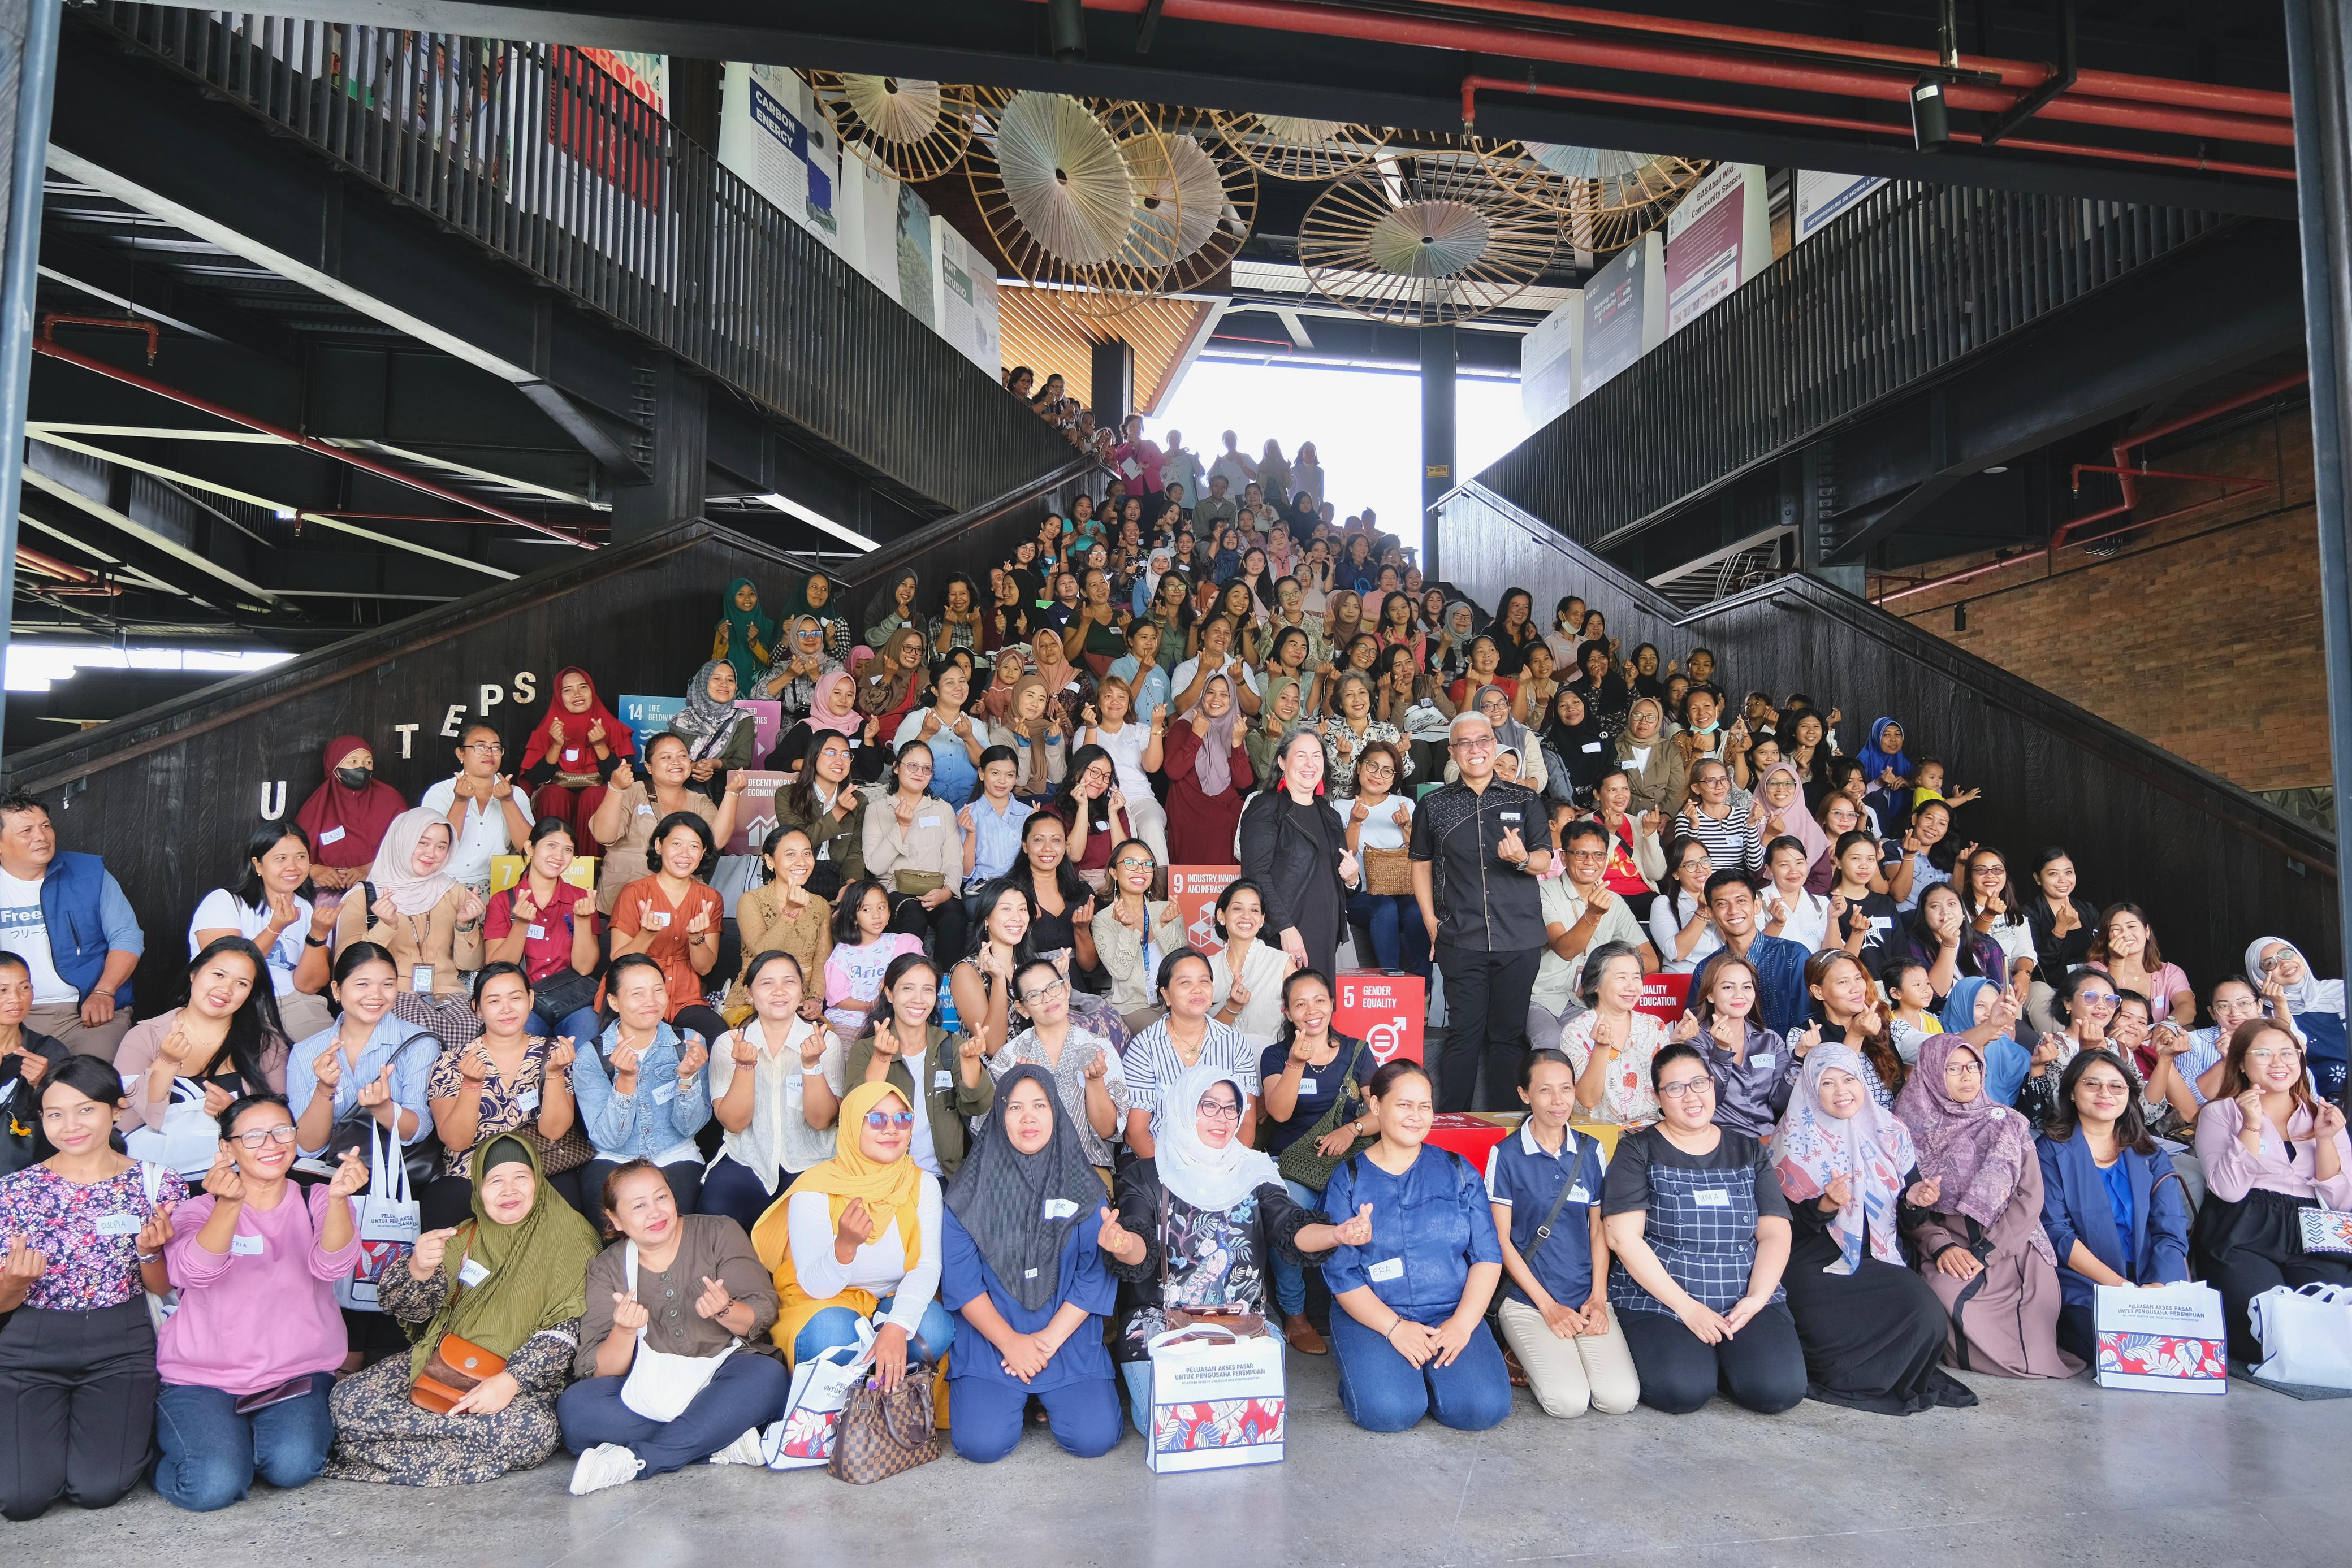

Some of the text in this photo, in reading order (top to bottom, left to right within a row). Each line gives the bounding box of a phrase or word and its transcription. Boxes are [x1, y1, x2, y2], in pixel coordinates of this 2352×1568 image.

[756, 90, 795, 134] CARBON
[756, 107, 793, 148] ENERGY
[1692, 172, 1741, 218] Community Spaces
[1807, 200, 1841, 227] ENTREPRENEURS
[1849, 183, 1866, 197] MONDE
[944, 258, 957, 276] ANT
[945, 274, 967, 298] STUDIO
[628, 704, 643, 721] 14
[502, 865, 512, 886] 7
[569, 865, 585, 875] AND
[1173, 874, 1183, 893] 9
[1188, 874, 1218, 884] INDUSTRY,
[1, 910, 44, 923] Free
[1343, 986, 1354, 1007] 5
[1363, 985, 1391, 996] GENDER
[1363, 998, 1396, 1008] EQUALITY
[1640, 997, 1676, 1006] EDUCATION
[1698, 1193, 1719, 1202] UMA
[1373, 1266, 1391, 1276] ERA
[824, 1384, 842, 1394] UNTUK
